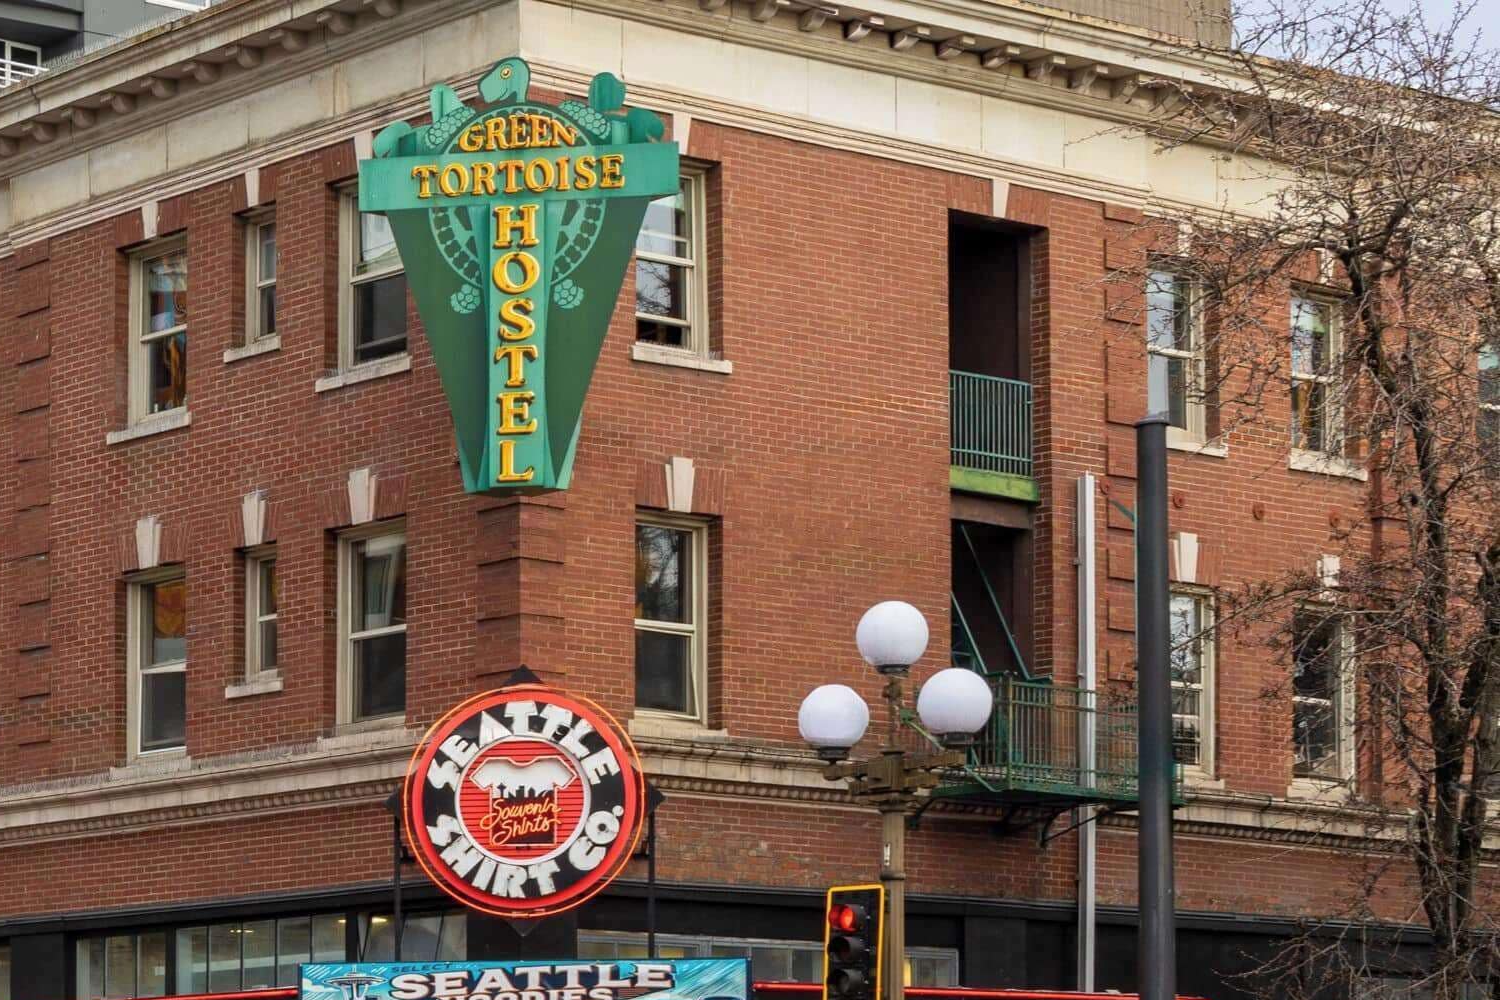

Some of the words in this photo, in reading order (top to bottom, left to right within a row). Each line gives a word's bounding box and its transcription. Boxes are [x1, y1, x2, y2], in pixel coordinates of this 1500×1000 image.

[459, 114, 577, 152] GREEN
[412, 154, 626, 198] TORTOISE
[493, 204, 541, 484] HOSTEL
[427, 700, 621, 791] SEATTLE
[480, 798, 562, 829] Souvenir
[492, 818, 562, 845] Shirts
[426, 814, 561, 898] SHIRT
[391, 963, 674, 1000] SEATTLE
